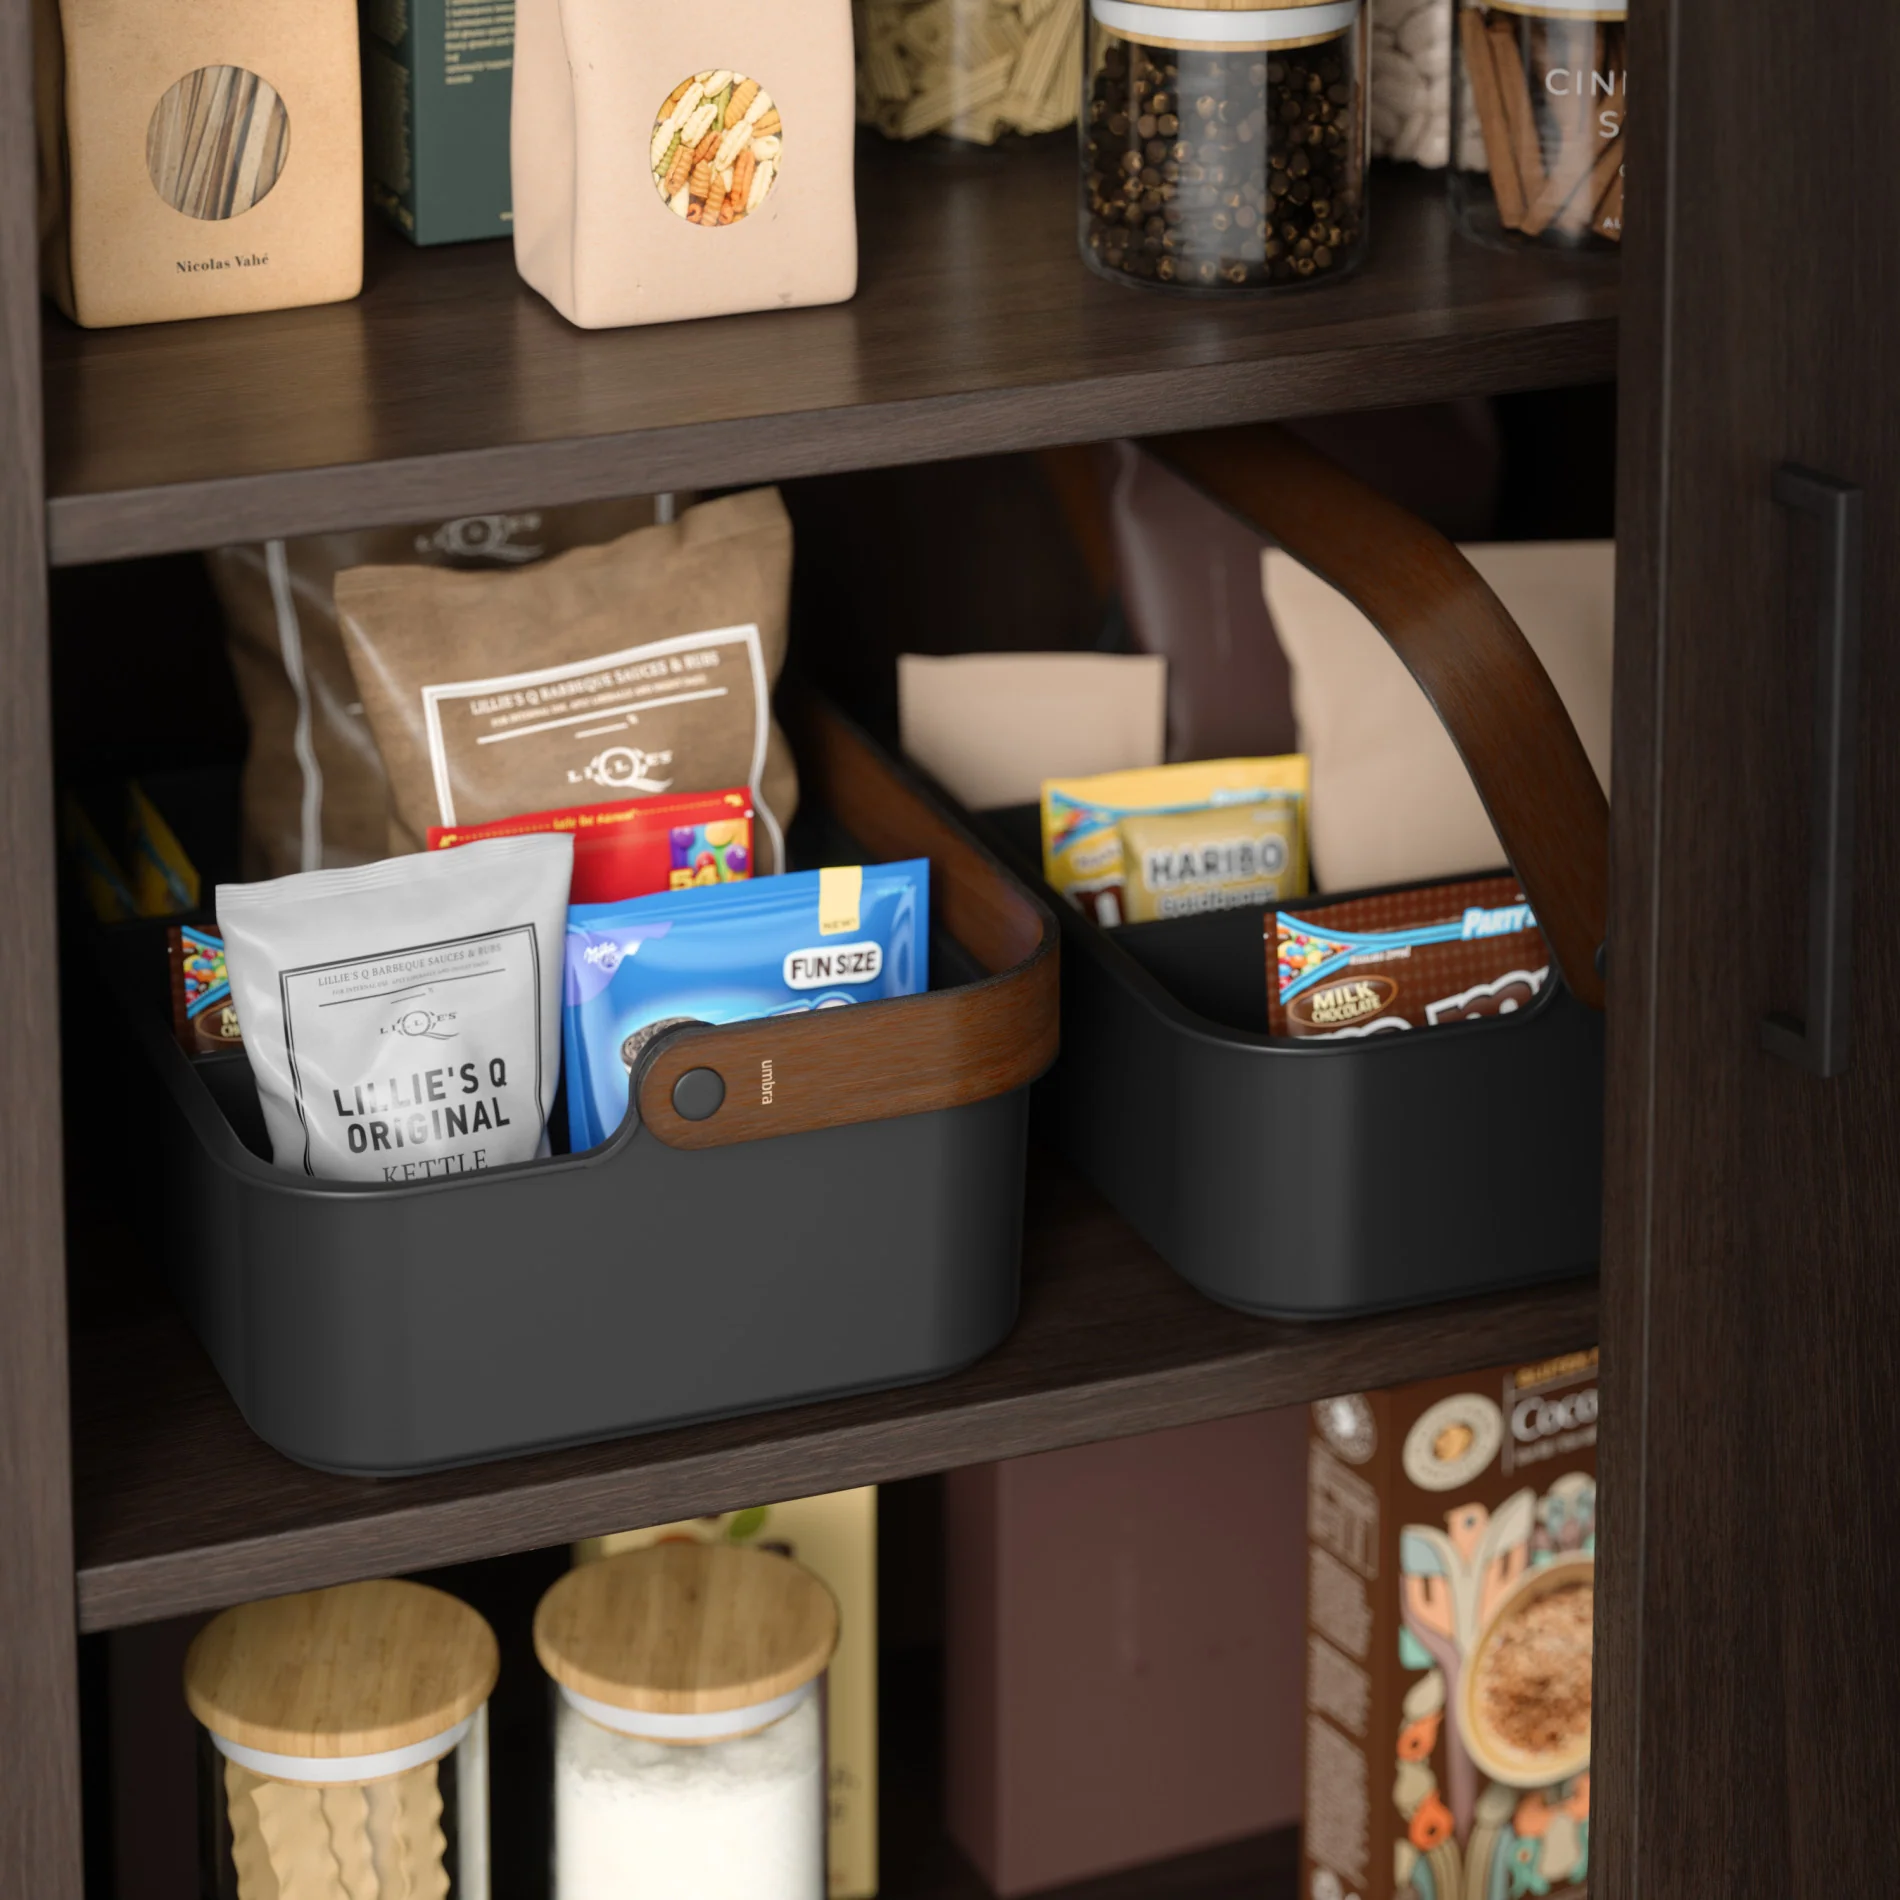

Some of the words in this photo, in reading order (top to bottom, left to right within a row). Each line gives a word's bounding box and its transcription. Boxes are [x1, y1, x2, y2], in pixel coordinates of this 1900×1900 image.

[1545, 68, 1627, 97] CIN
[176, 258, 231, 274] Nicolas
[234, 252, 270, 268] Vahé
[1150, 842, 1284, 883] HARIBO
[318, 970, 360, 987] LILLIE'S
[361, 968, 371, 980] Q
[372, 958, 426, 977] BARBEQUE
[427, 951, 465, 967] SAUCES
[467, 949, 475, 958] &
[477, 943, 502, 957] RUBS
[791, 956, 831, 980] FUN
[836, 951, 877, 975] SIZE
[1311, 994, 1382, 1023] CHOCOLATE
[1312, 980, 1376, 1011] MILK
[333, 1062, 479, 1116] LILLIE'S
[489, 1057, 508, 1088] Q
[761, 1059, 776, 1105] umbra
[347, 1097, 511, 1154] ORIGINAL
[382, 1149, 489, 1183] KETTLE
